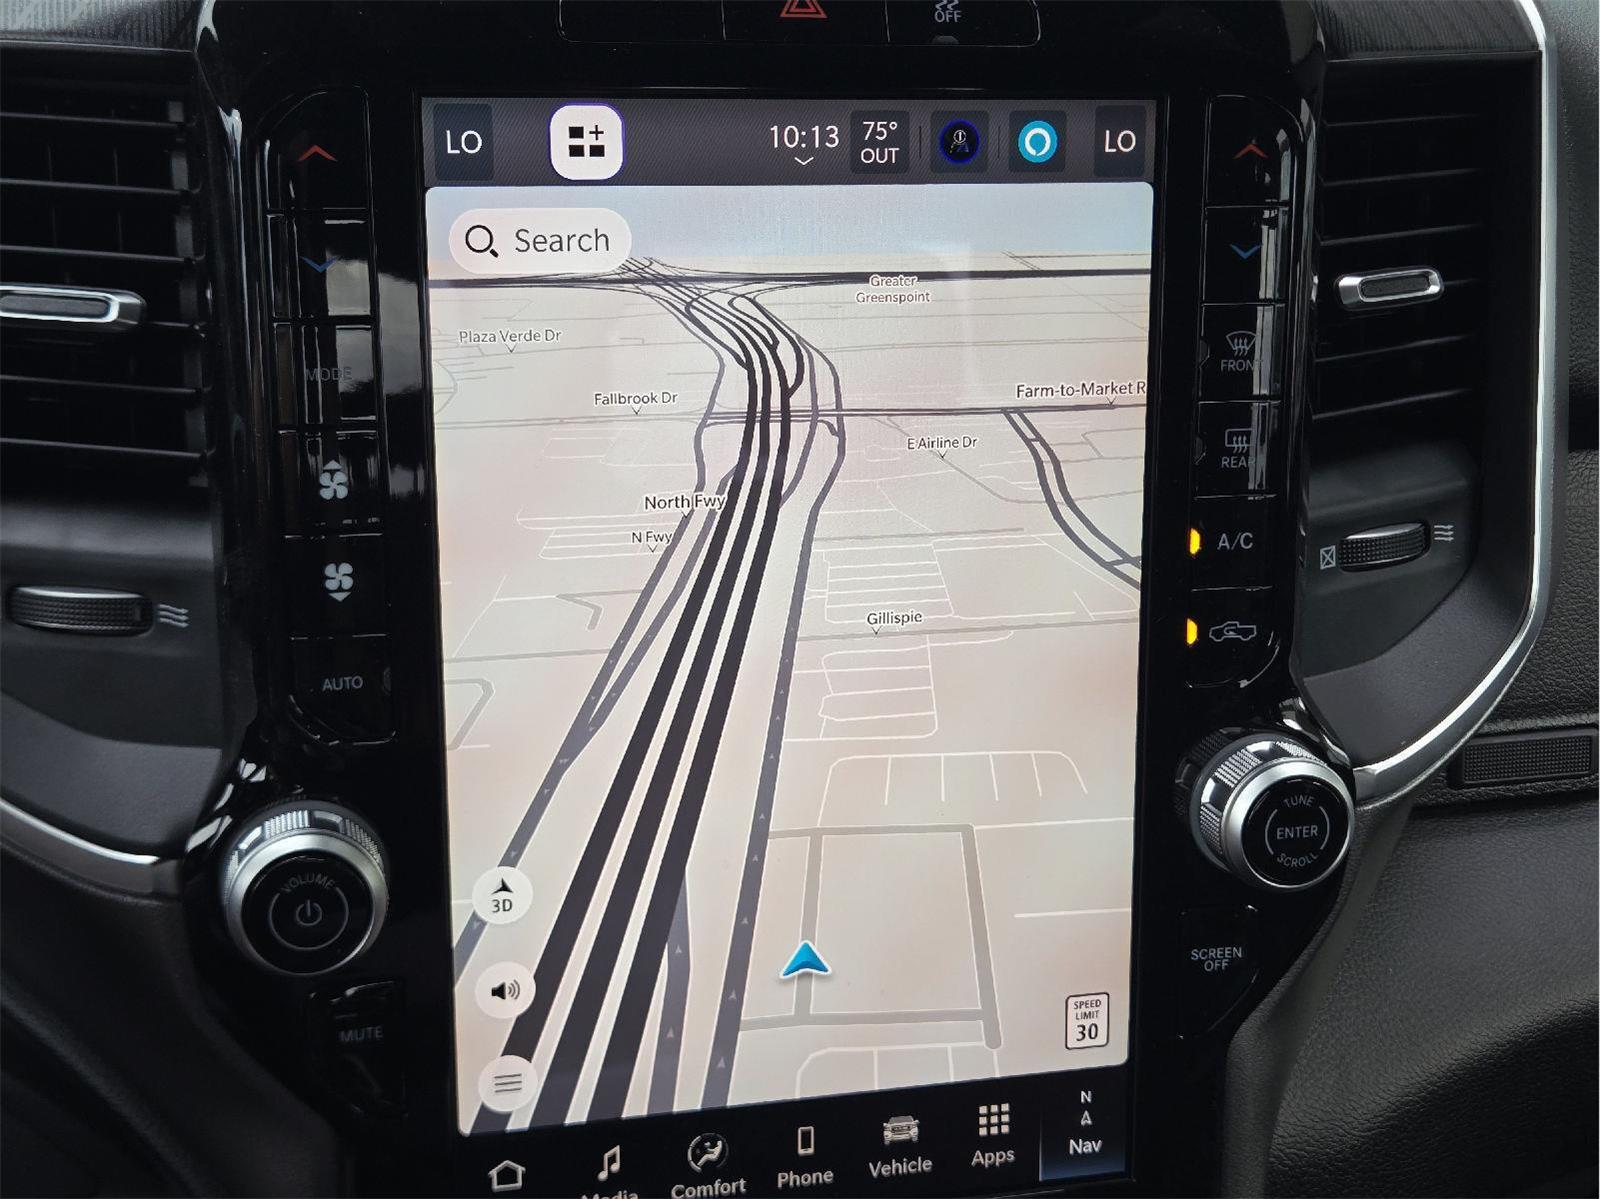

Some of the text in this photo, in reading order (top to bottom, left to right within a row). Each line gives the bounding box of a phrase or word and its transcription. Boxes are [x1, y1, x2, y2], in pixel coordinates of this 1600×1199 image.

[935, 8, 962, 24] OFF
[770, 125, 840, 149] 10:13
[863, 121, 898, 141] 75°
[446, 129, 482, 155] LO
[1105, 129, 1136, 154] LO
[860, 148, 900, 164] OUT
[514, 226, 610, 254] Search
[870, 274, 918, 289] Greater
[856, 290, 931, 304] Greenspoint
[459, 329, 562, 343] Plaza Verde Dr
[306, 367, 352, 382] MODE
[1016, 382, 1147, 398] Farm-to-Market R
[594, 392, 678, 406] Fallbrook Dr
[907, 436, 977, 449] E Airline Dr
[1221, 456, 1255, 468] REAR
[645, 494, 726, 511] North Fwy
[632, 530, 673, 547] N Fwy
[1217, 532, 1253, 550] A/C
[867, 611, 922, 626] Gillispie
[322, 675, 363, 691] AUTO
[1283, 794, 1314, 809] TUNE
[1276, 825, 1318, 840] ENTER
[1276, 852, 1318, 868] SCROLL
[281, 871, 335, 892] VOLUME
[491, 898, 513, 913] 3D
[1191, 947, 1242, 960] SCREEN
[1204, 959, 1229, 972] OFF
[1073, 999, 1101, 1011] SPEED
[1075, 1009, 1099, 1021] LIMIT
[340, 1026, 383, 1043] MUTE
[1076, 1023, 1099, 1042] 30
[1080, 1090, 1092, 1104] N
[1068, 1138, 1102, 1156] Nav
[971, 1148, 1015, 1168] Apps
[869, 1156, 932, 1178] Vehicle
[777, 1169, 834, 1189] Phone
[581, 1190, 639, 1199] dia
[671, 1178, 747, 1199] Comfort
